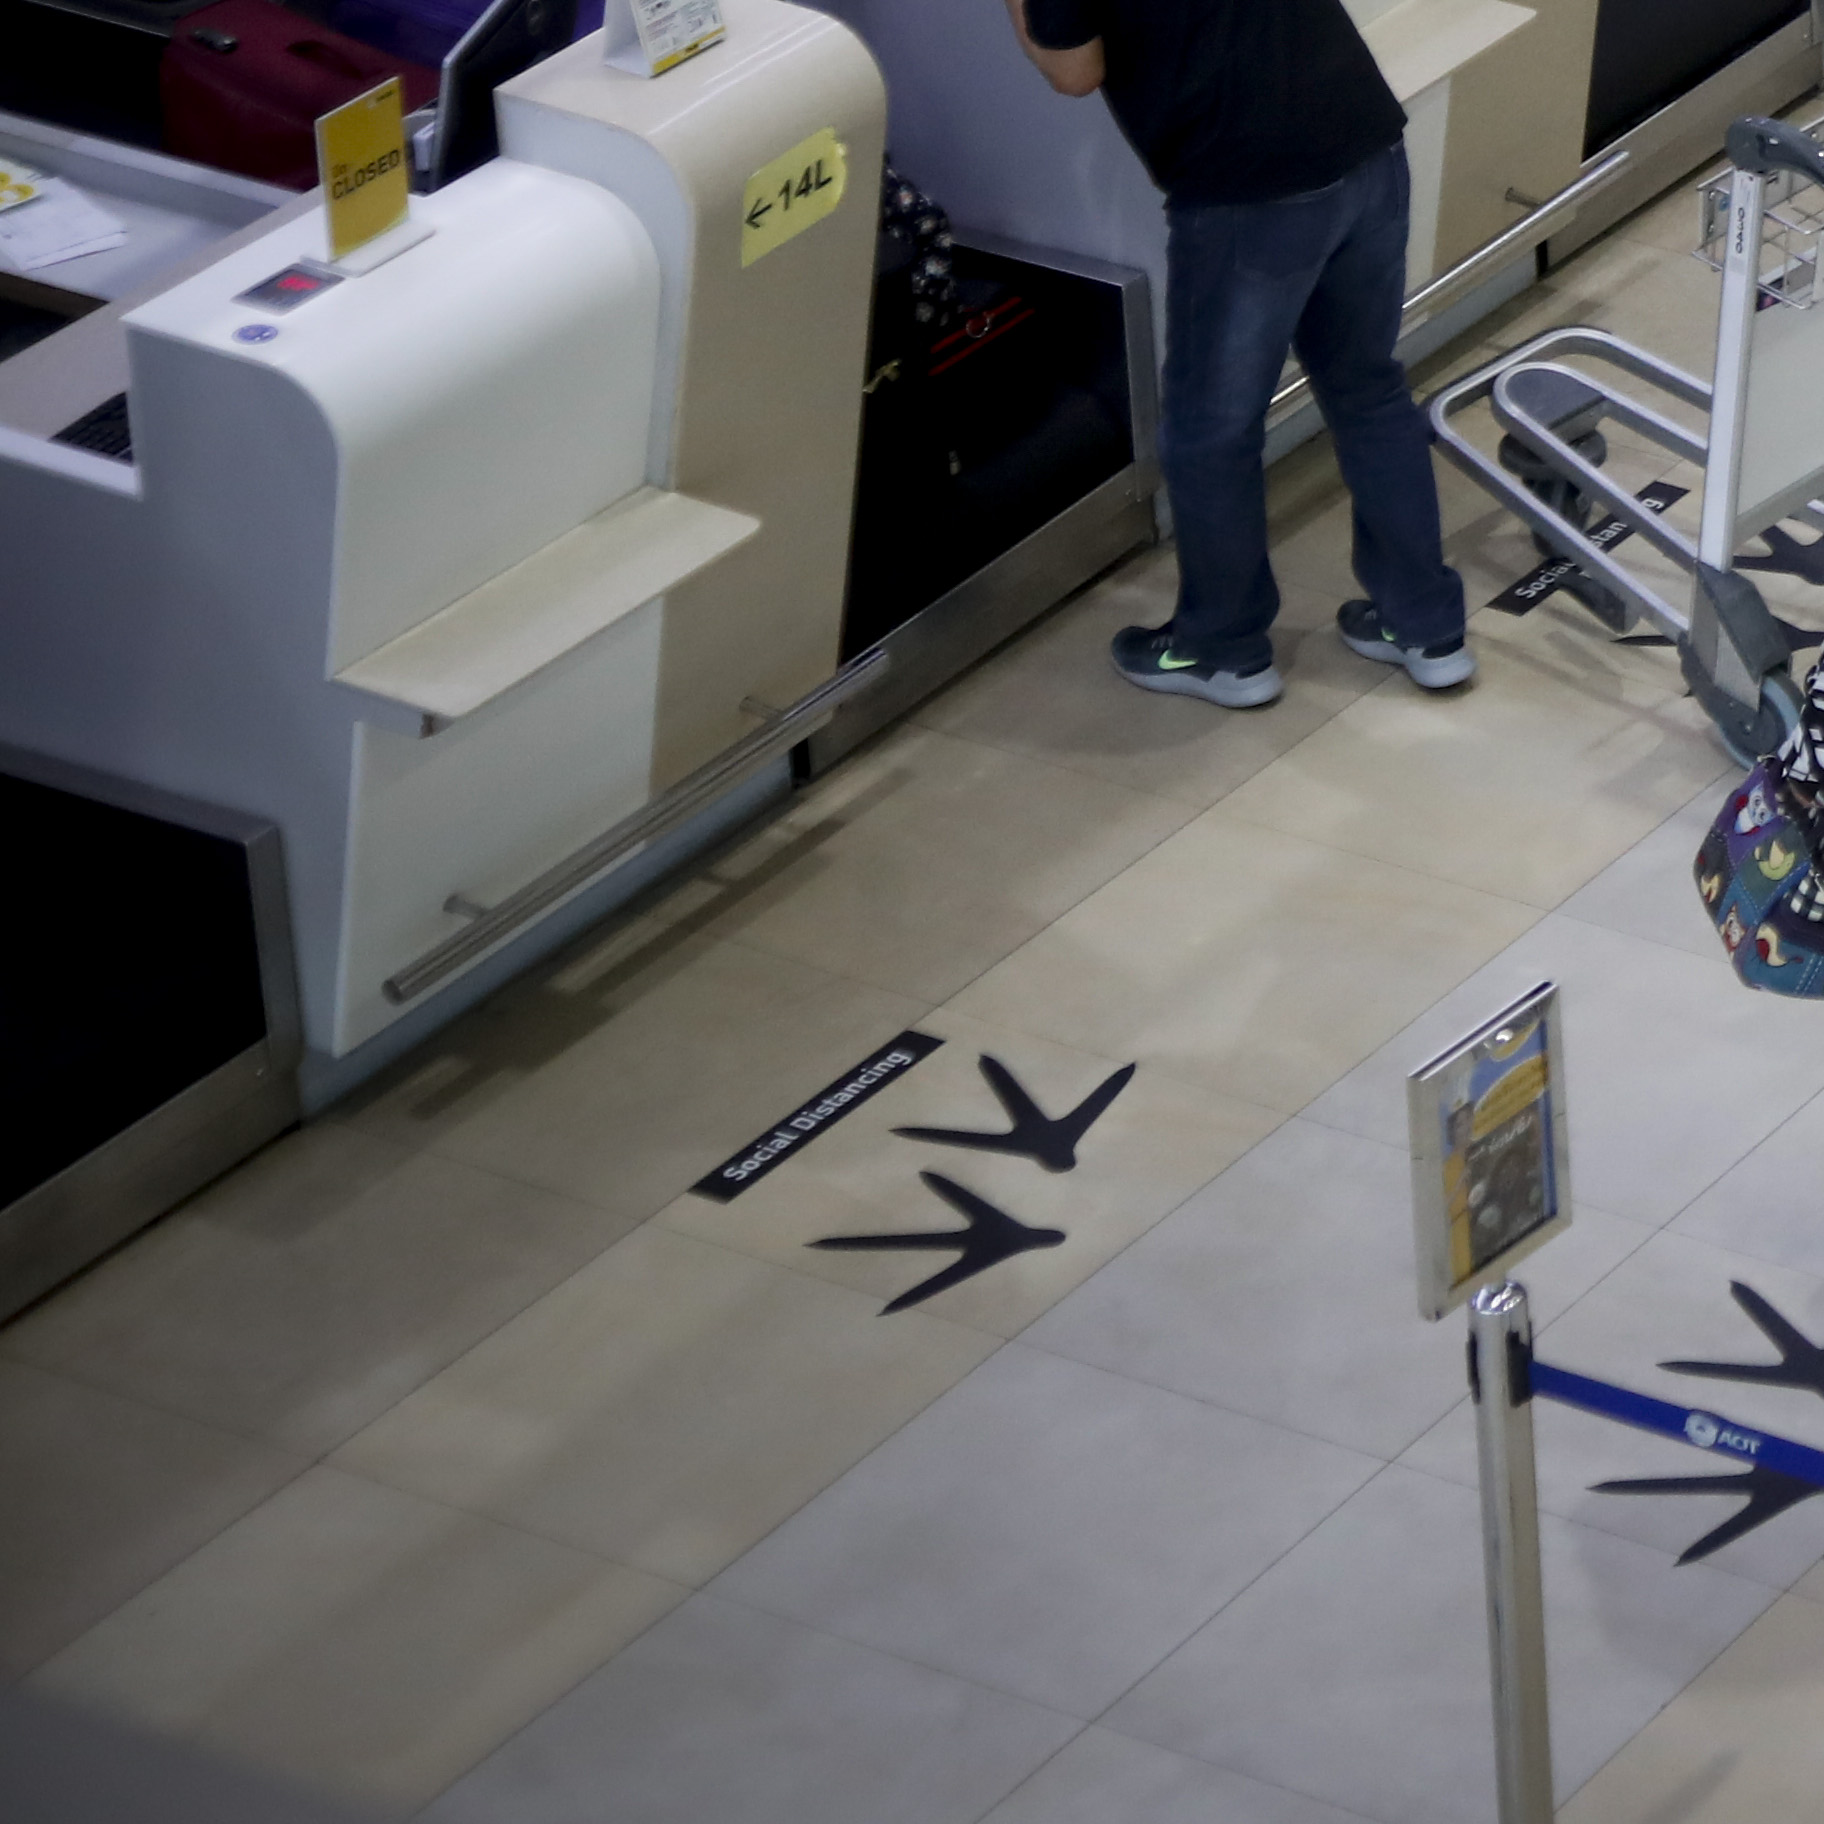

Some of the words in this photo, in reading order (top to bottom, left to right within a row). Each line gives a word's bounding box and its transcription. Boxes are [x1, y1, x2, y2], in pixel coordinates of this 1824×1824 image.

[333, 149, 400, 201] CLOSED
[778, 159, 832, 211] 14L
[722, 1128, 800, 1181] Social
[790, 1048, 913, 1133] Distancing
[1718, 1430, 1760, 1455] AOT
